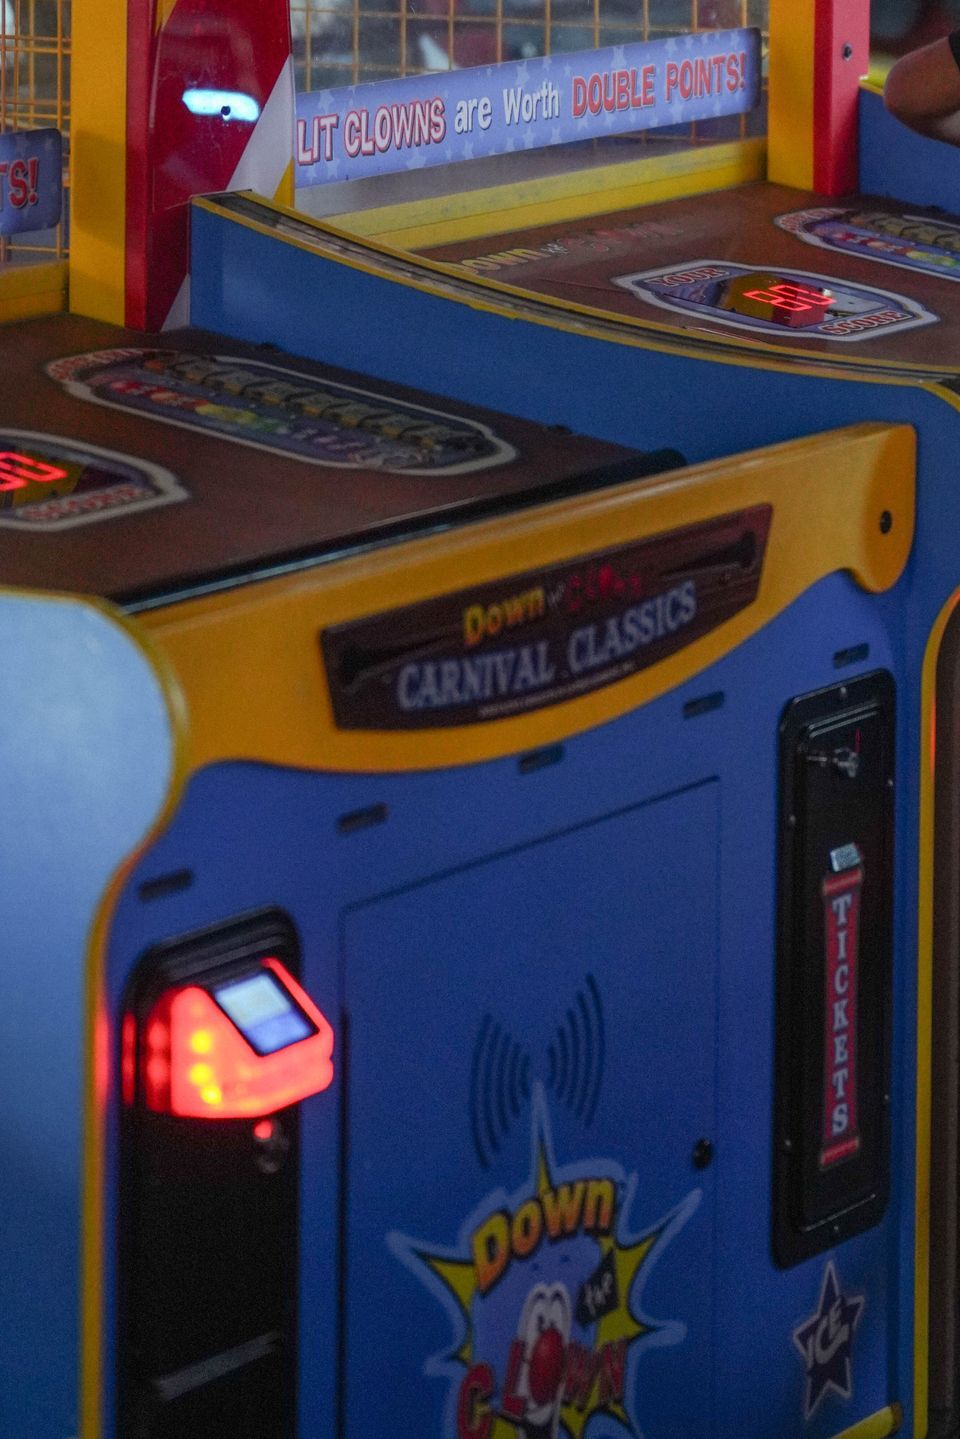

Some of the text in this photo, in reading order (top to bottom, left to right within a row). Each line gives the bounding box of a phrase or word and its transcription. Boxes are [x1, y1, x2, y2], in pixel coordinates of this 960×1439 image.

[297, 52, 747, 166] LIT CLOWNS are Worth DOUBLE POINTS!
[646, 267, 731, 288] YOUR
[820, 310, 910, 336] SCORE
[399, 643, 559, 710] CARNIVAL
[568, 581, 696, 674] CLASSICS
[831, 894, 852, 1135] TICKETS
